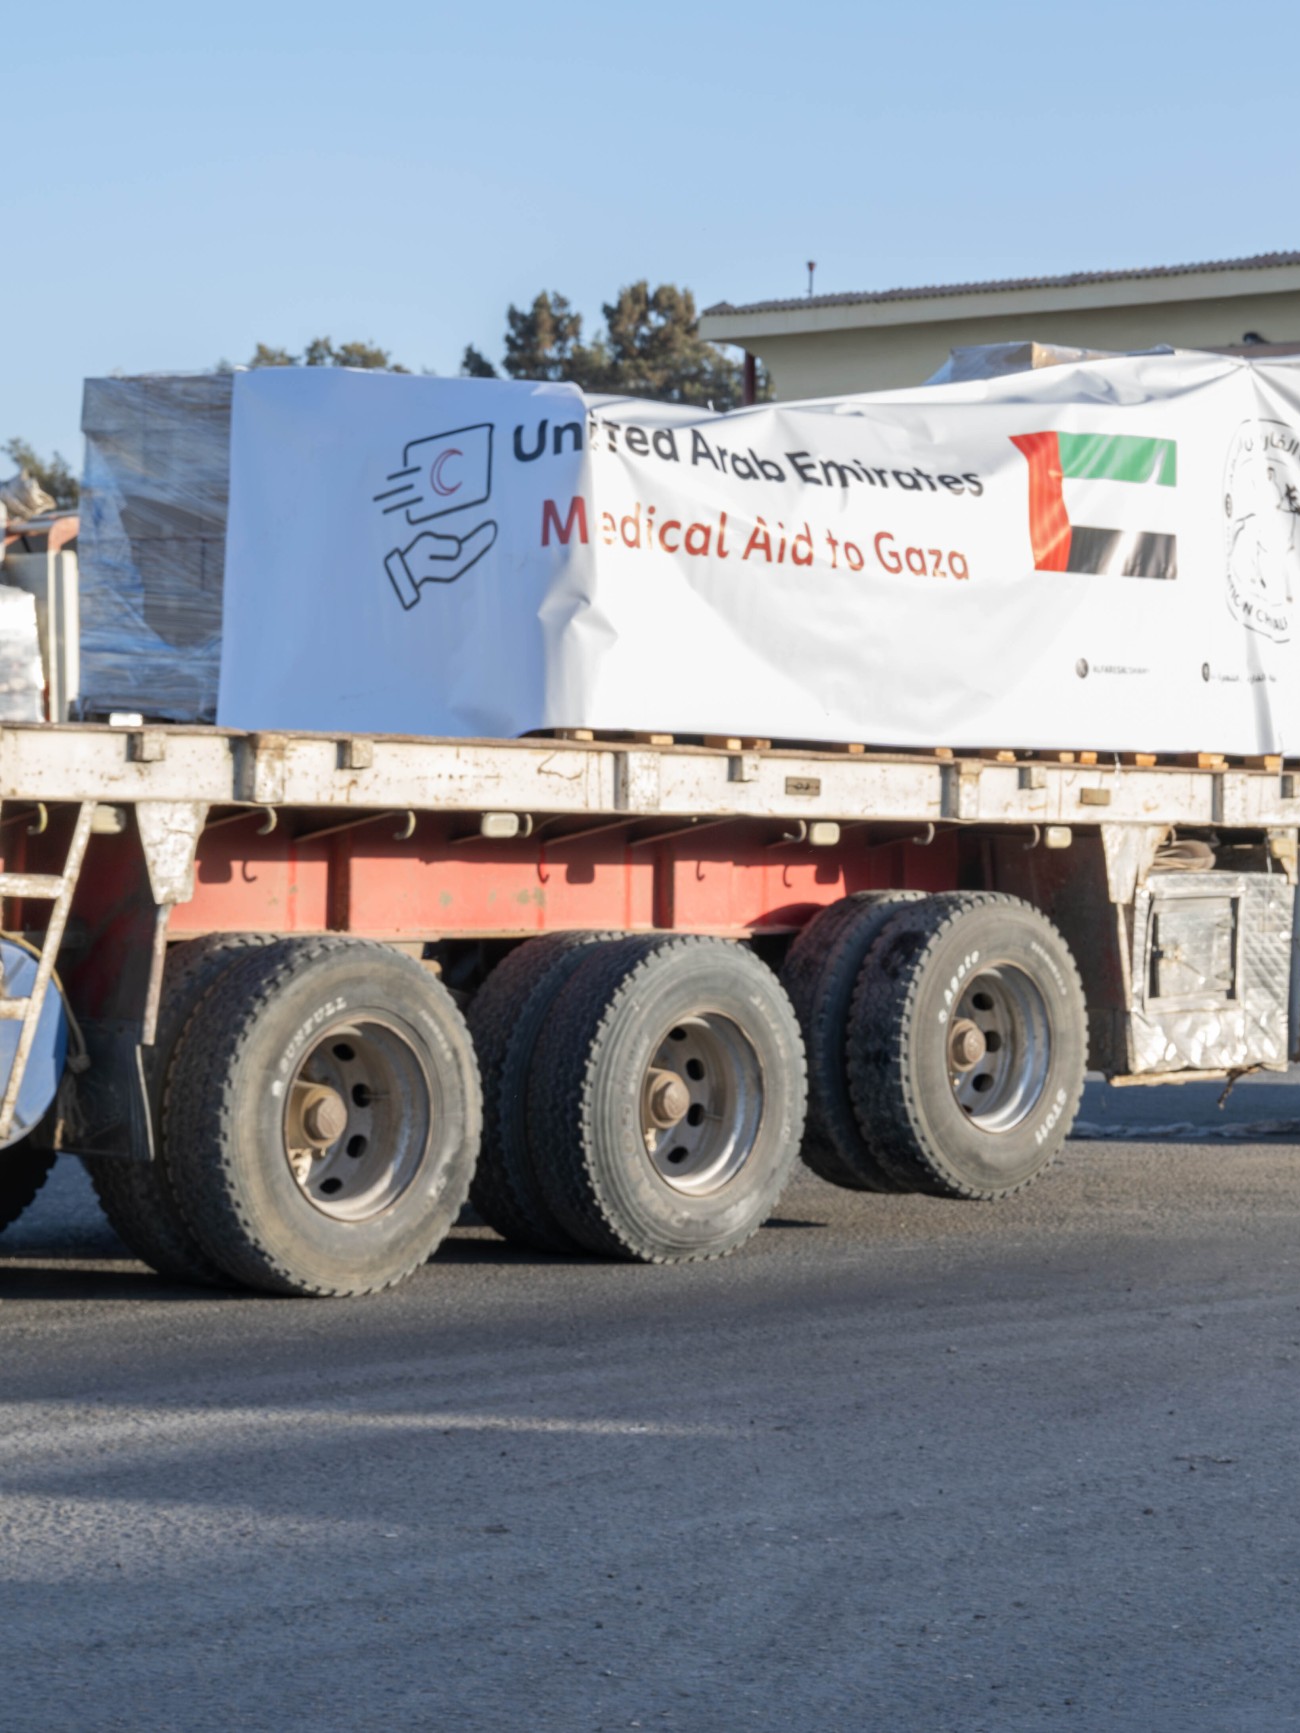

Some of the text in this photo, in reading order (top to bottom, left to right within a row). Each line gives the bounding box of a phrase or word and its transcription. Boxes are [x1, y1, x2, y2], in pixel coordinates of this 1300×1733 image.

[691, 428, 786, 483] Arab
[785, 451, 984, 497] Emirates
[541, 496, 970, 580] Medical Aid to Gaza
